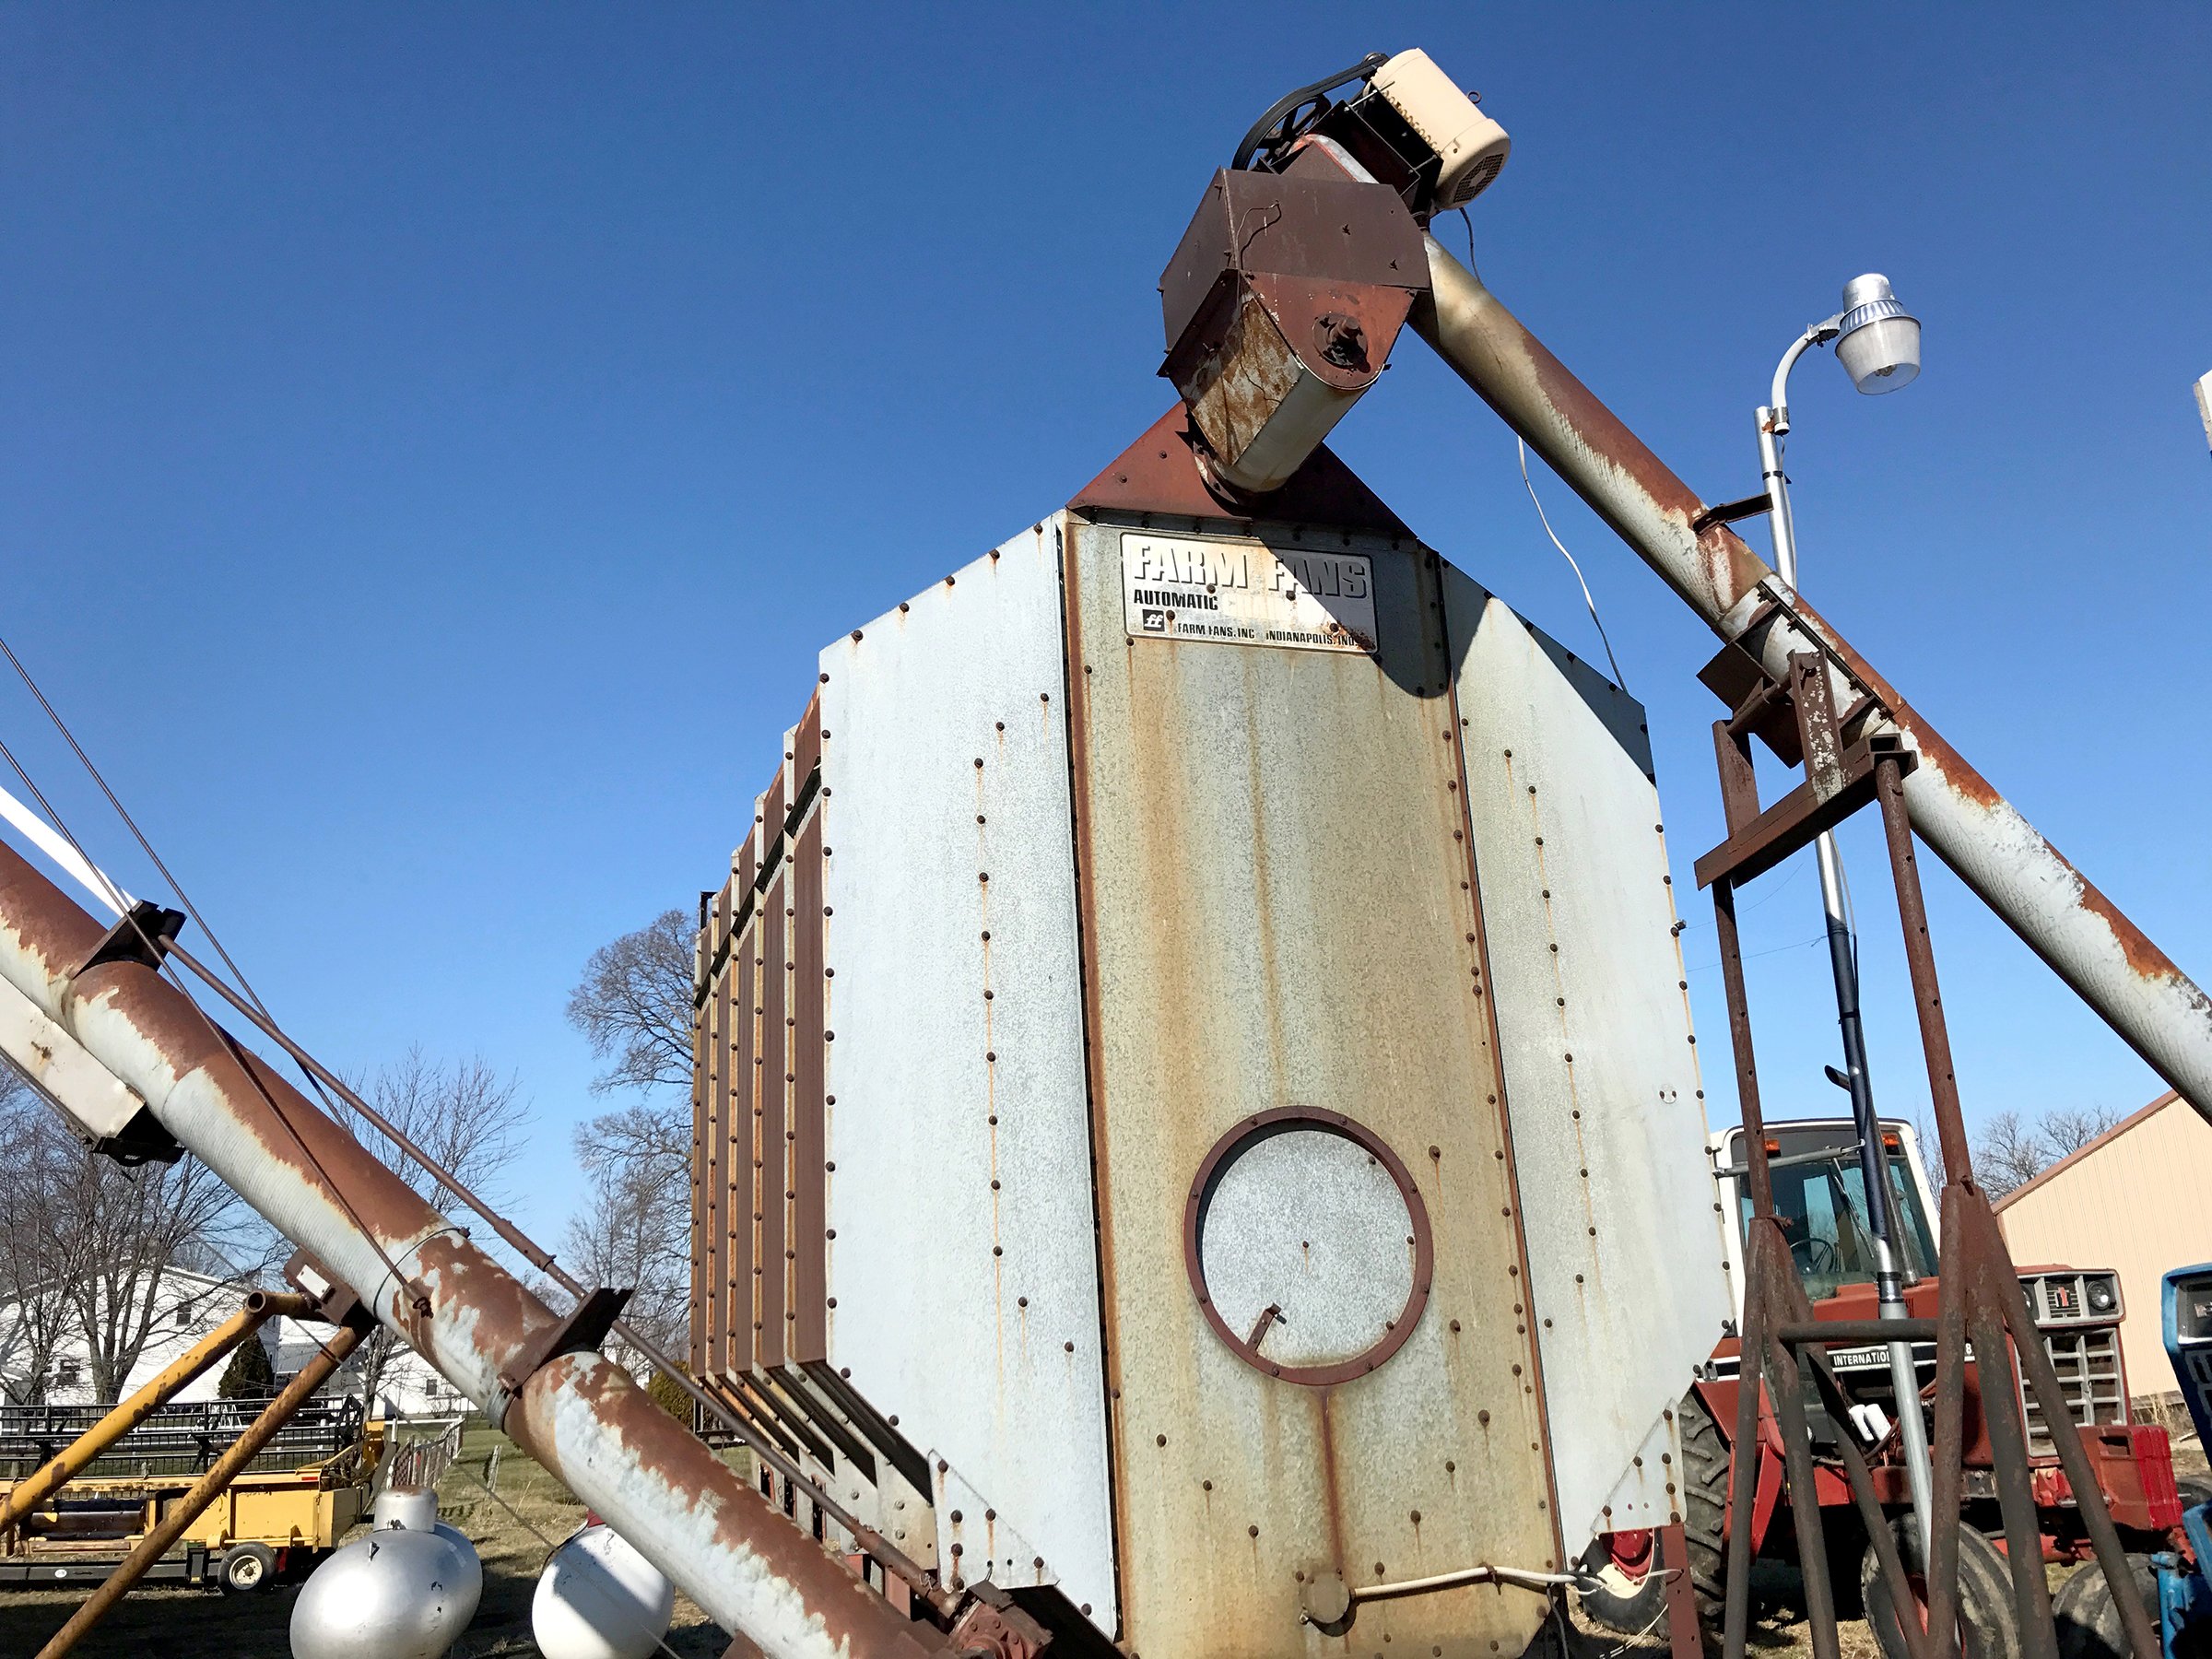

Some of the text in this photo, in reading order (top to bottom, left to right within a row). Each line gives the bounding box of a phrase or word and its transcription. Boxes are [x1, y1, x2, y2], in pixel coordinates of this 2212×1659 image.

[1133, 546, 1368, 598] FARM FANS
[1134, 589, 1218, 610] AUTOMATIC
[1177, 622, 1206, 635] FARM
